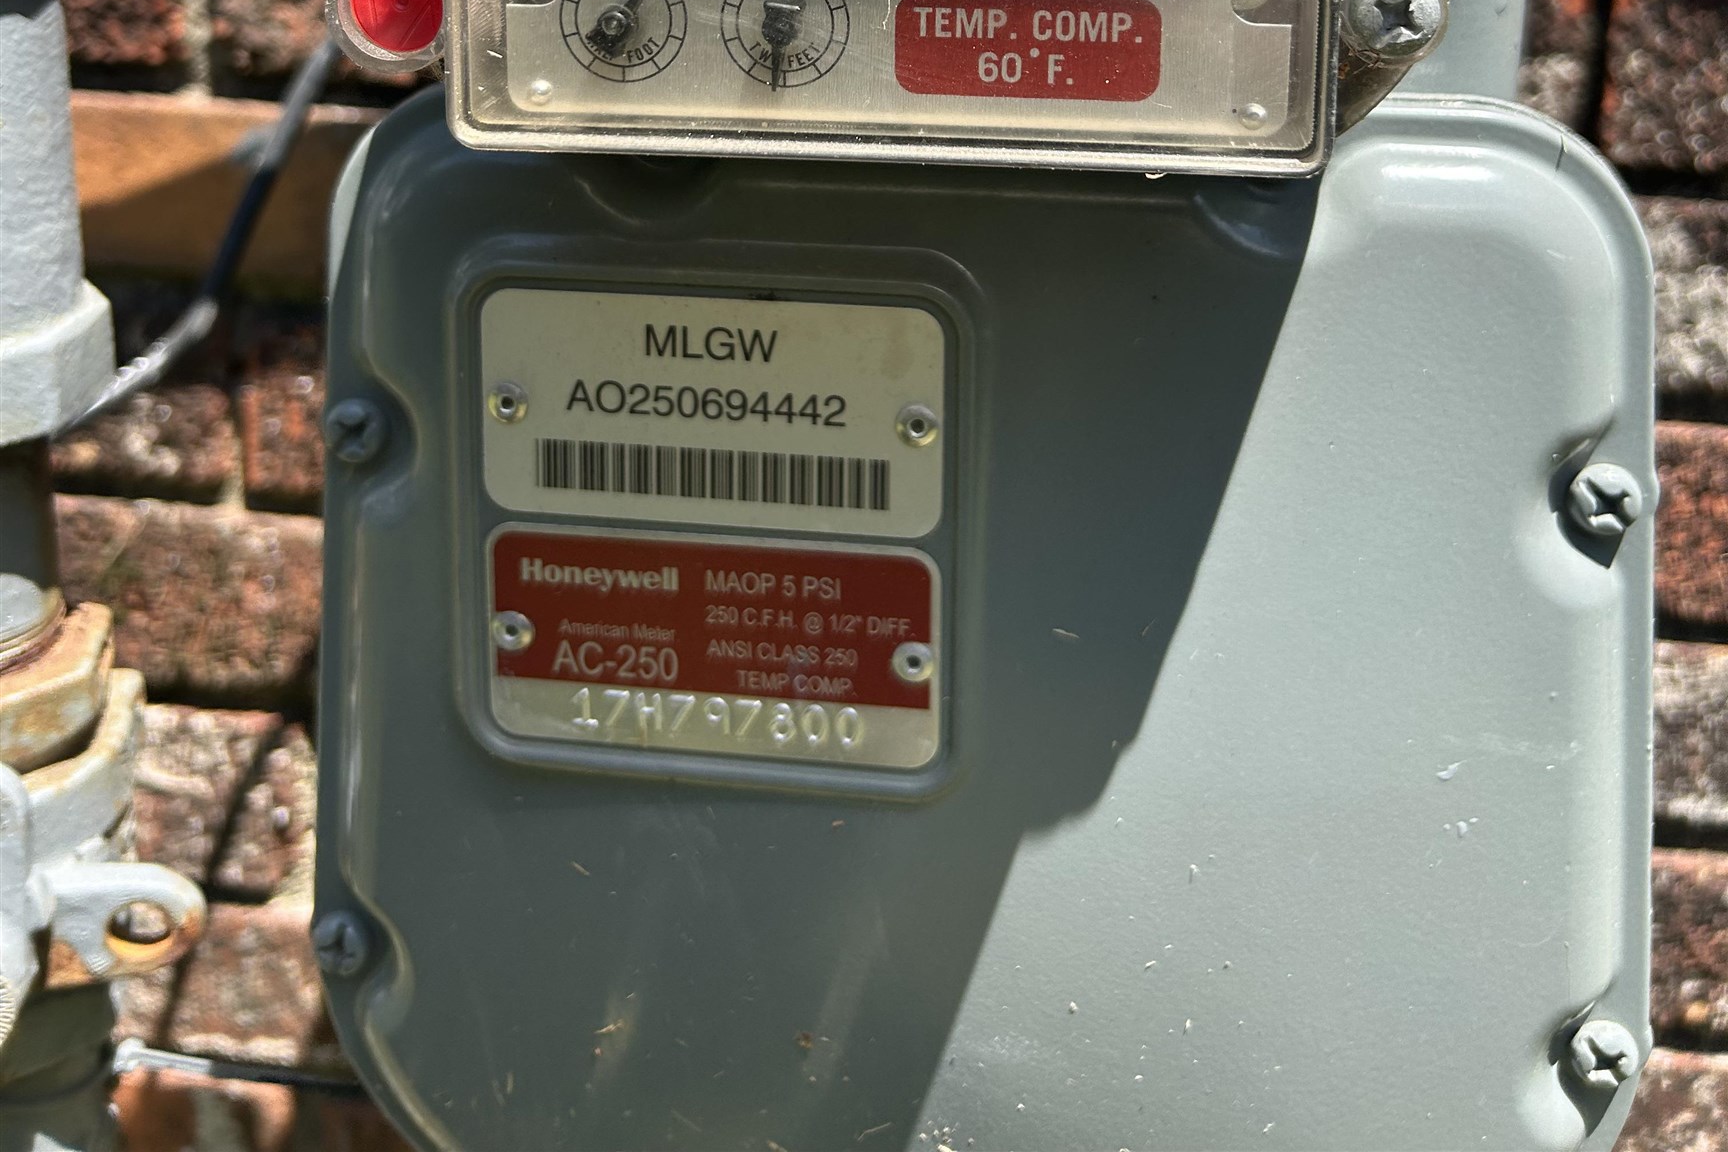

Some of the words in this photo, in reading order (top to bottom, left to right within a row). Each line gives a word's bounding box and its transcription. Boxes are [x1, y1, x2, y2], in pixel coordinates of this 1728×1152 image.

[915, 7, 1018, 40] TEMP.
[1032, 10, 1143, 43] COMP.
[626, 36, 661, 63] FOOT
[787, 42, 821, 69] FEET
[645, 324, 778, 363] MLGW
[521, 556, 679, 593] Honeywell
[705, 569, 776, 595] MAOP
[782, 575, 796, 597] 5
[802, 576, 841, 599] PSI
[559, 619, 629, 638] American
[633, 624, 676, 641] Meter
[704, 604, 739, 625] 250
[804, 612, 824, 634] @
[553, 640, 678, 681] AC-250
[707, 639, 752, 659] ANSI
[757, 642, 820, 664] CLASS
[824, 648, 858, 667] 250
[572, 687, 863, 745] 17H797800
